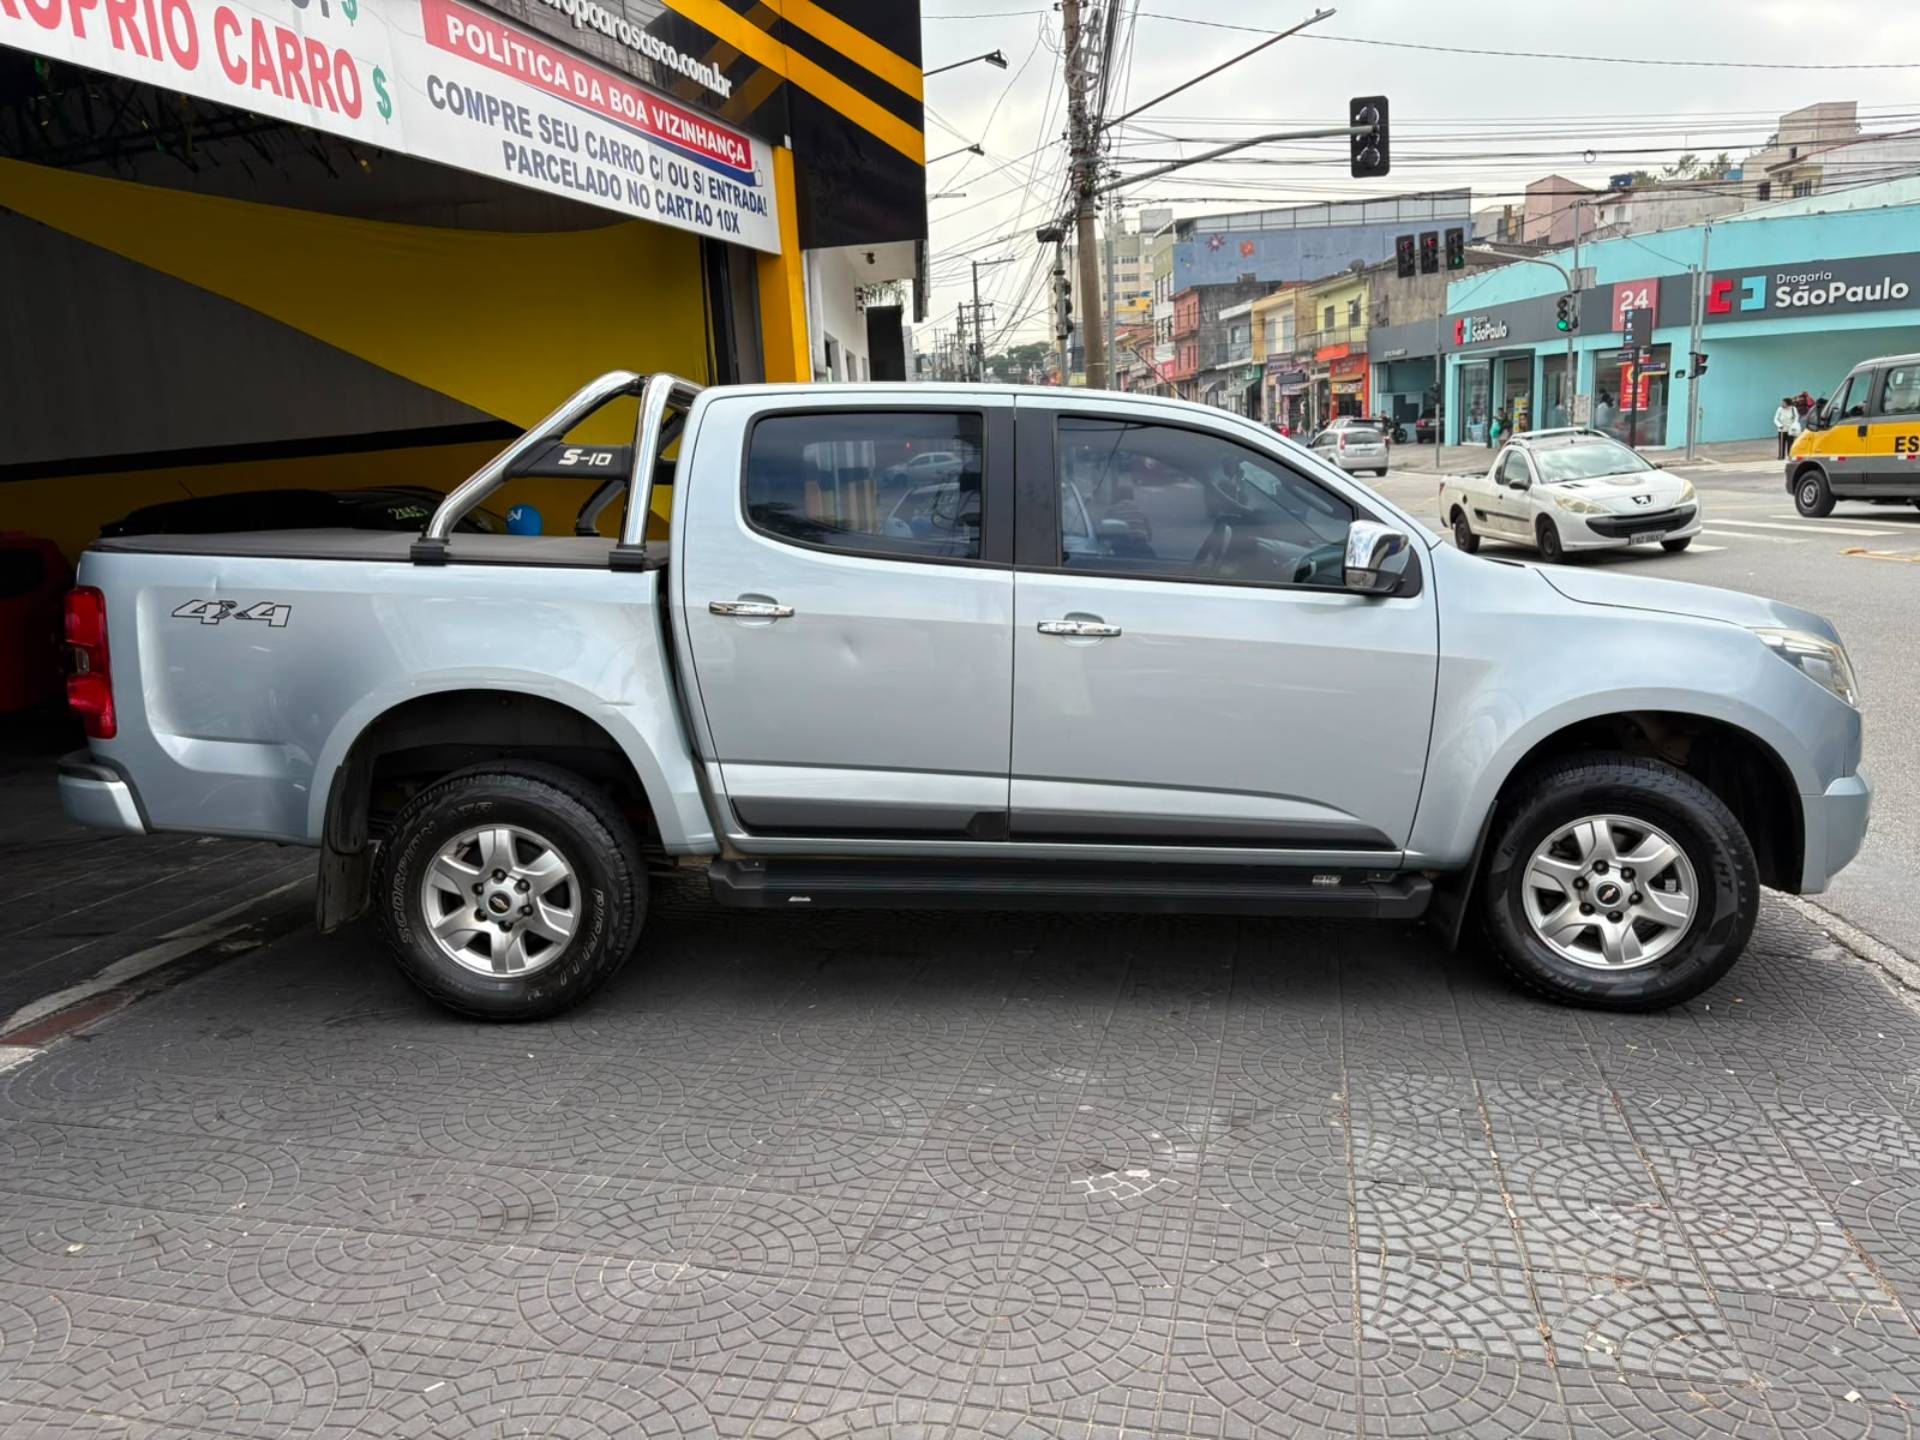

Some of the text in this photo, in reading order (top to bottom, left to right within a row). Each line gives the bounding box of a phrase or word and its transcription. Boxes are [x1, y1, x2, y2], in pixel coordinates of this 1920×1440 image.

[214, 6, 362, 119] CARRO
[373, 65, 392, 125] $
[446, 14, 747, 165] POLÍTICA DA BOA VIZINHANÇA
[427, 74, 533, 140] COMPRE
[538, 113, 580, 153] SEU
[586, 131, 644, 175] CARRO
[667, 162, 689, 190] OU
[709, 176, 767, 217] ENTRADA!
[503, 140, 622, 201] PARCELADO
[627, 179, 650, 210] NO
[717, 209, 740, 234] 10X
[1620, 288, 1648, 311] 24
[1775, 277, 1909, 308] SãoPaulo
[1776, 271, 1833, 285] Drogaria
[558, 448, 613, 466] S-10
